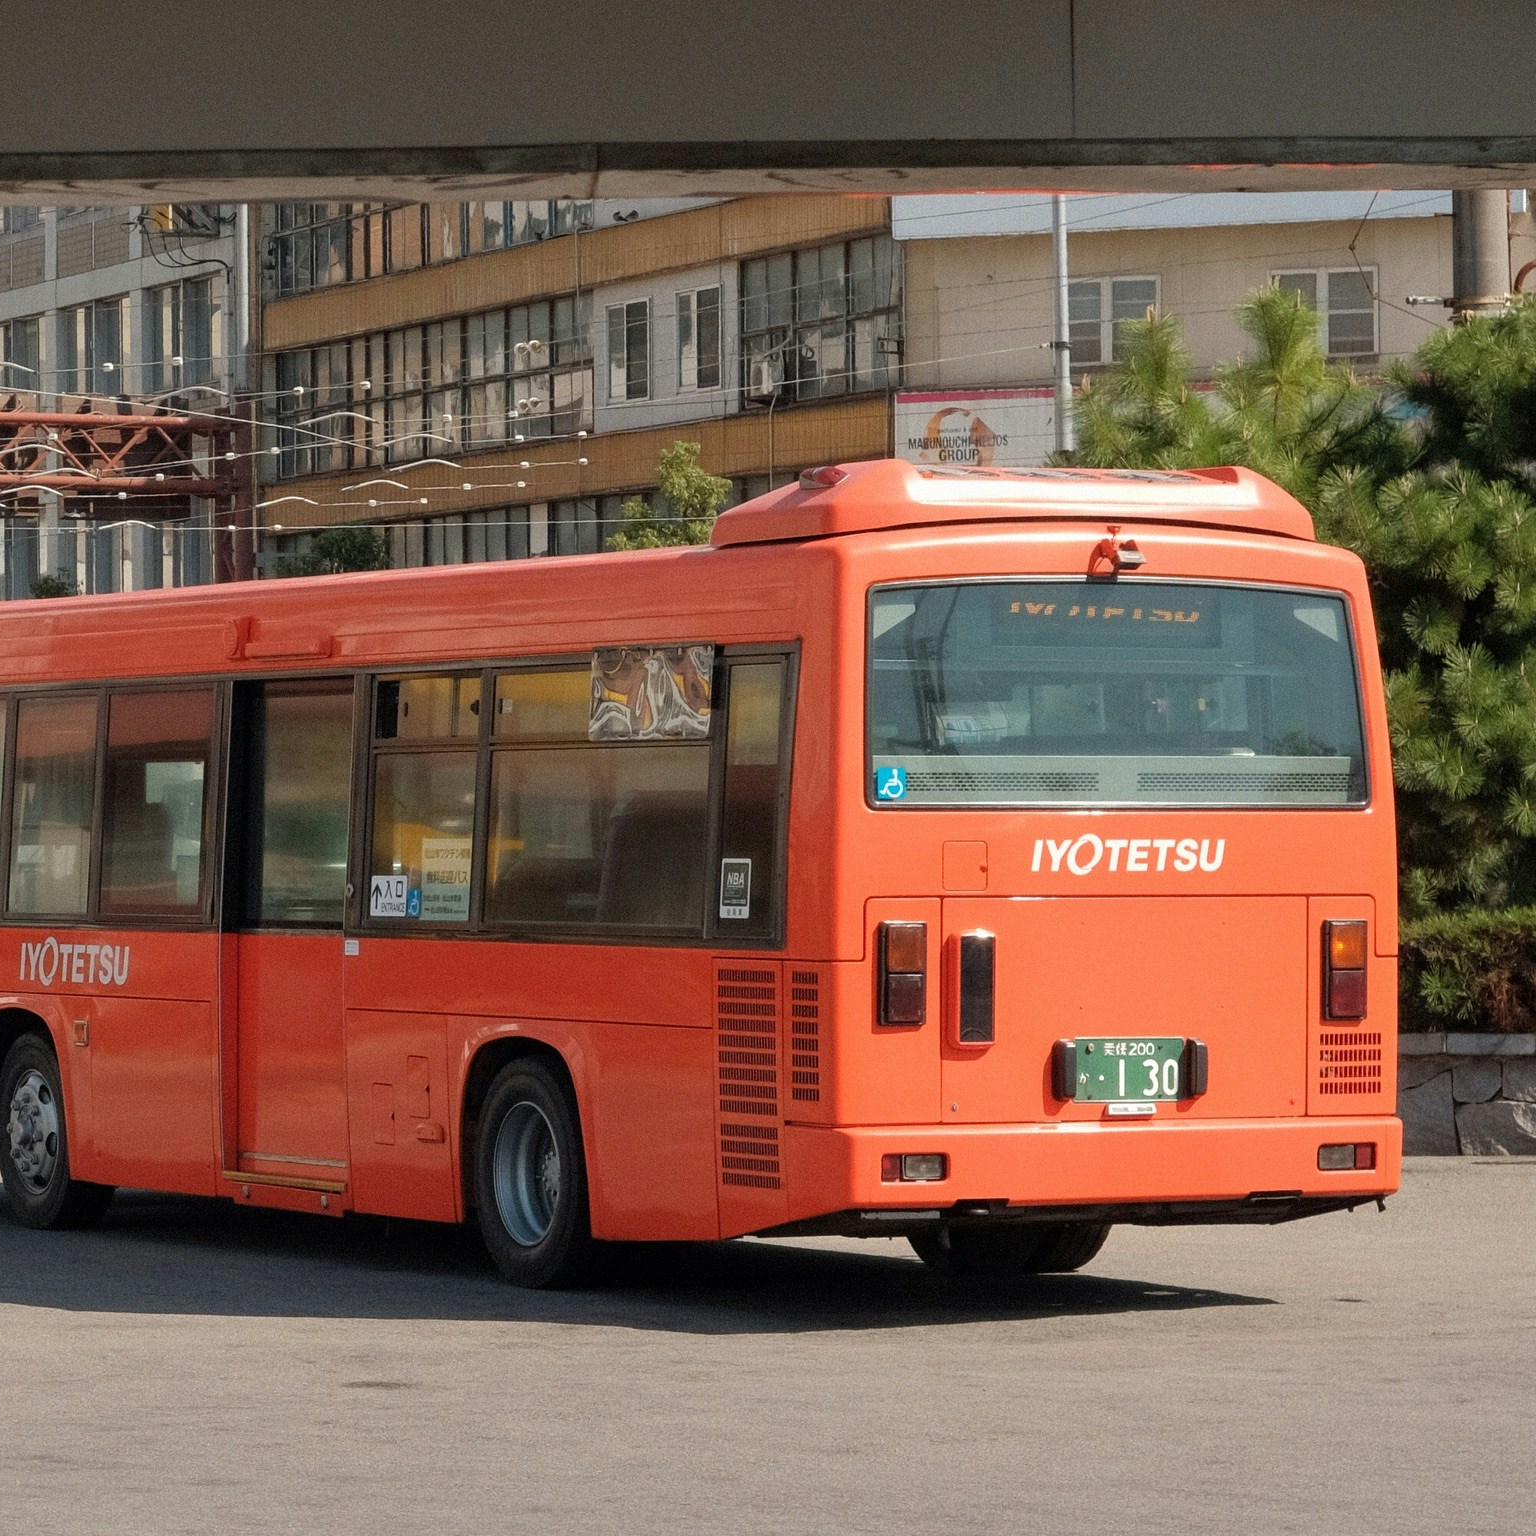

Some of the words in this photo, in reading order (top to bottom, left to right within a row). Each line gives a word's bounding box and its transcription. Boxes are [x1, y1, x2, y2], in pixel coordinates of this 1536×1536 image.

[938, 448, 980, 462] GROUP
[1031, 833, 1225, 875] IYOTETSU
[726, 872, 744, 885] NBA
[384, 880, 403, 898] 入口
[19, 936, 130, 986] IYOTETSU
